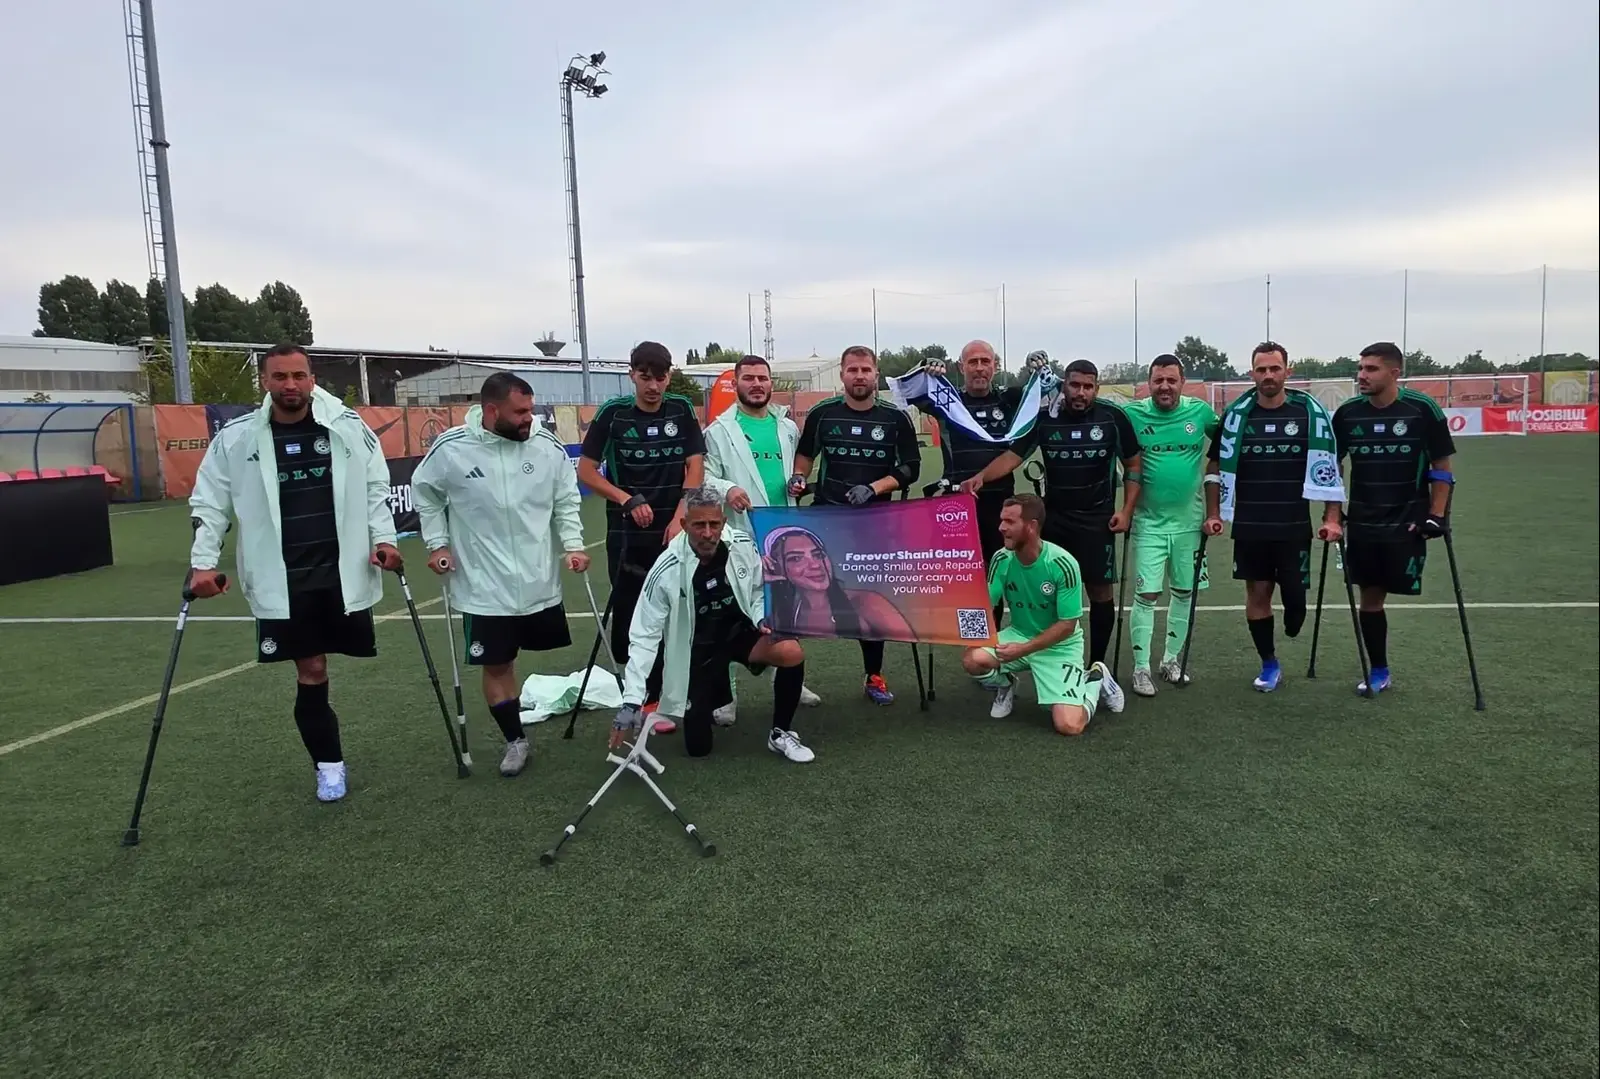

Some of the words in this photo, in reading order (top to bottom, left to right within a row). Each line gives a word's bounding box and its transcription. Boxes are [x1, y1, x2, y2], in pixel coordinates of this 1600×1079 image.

[1506, 409, 1587, 422] IMPOSIBILUL
[165, 438, 209, 452] FCSB
[1141, 443, 1199, 452] VOLVO
[1241, 444, 1301, 453] VOLVO
[1348, 445, 1411, 454] VOLVO
[619, 446, 684, 459] VOLVO
[752, 451, 783, 460] OLV
[825, 446, 886, 458] VOLVO
[1047, 449, 1107, 459] VOLVO
[277, 466, 332, 482] OLV
[388, 484, 414, 515] #FO
[936, 511, 968, 522] NOVA
[845, 552, 896, 561] Forever
[897, 549, 933, 560] Shani
[935, 548, 975, 561] Gabay
[917, 561, 944, 571] Love,
[857, 573, 882, 583] We'll
[884, 573, 923, 582] forever
[925, 574, 953, 583] carry
[955, 573, 973, 581] out
[892, 585, 918, 595] your
[919, 584, 943, 594] wish
[699, 595, 734, 615] OLV
[1061, 663, 1083, 687] 77
